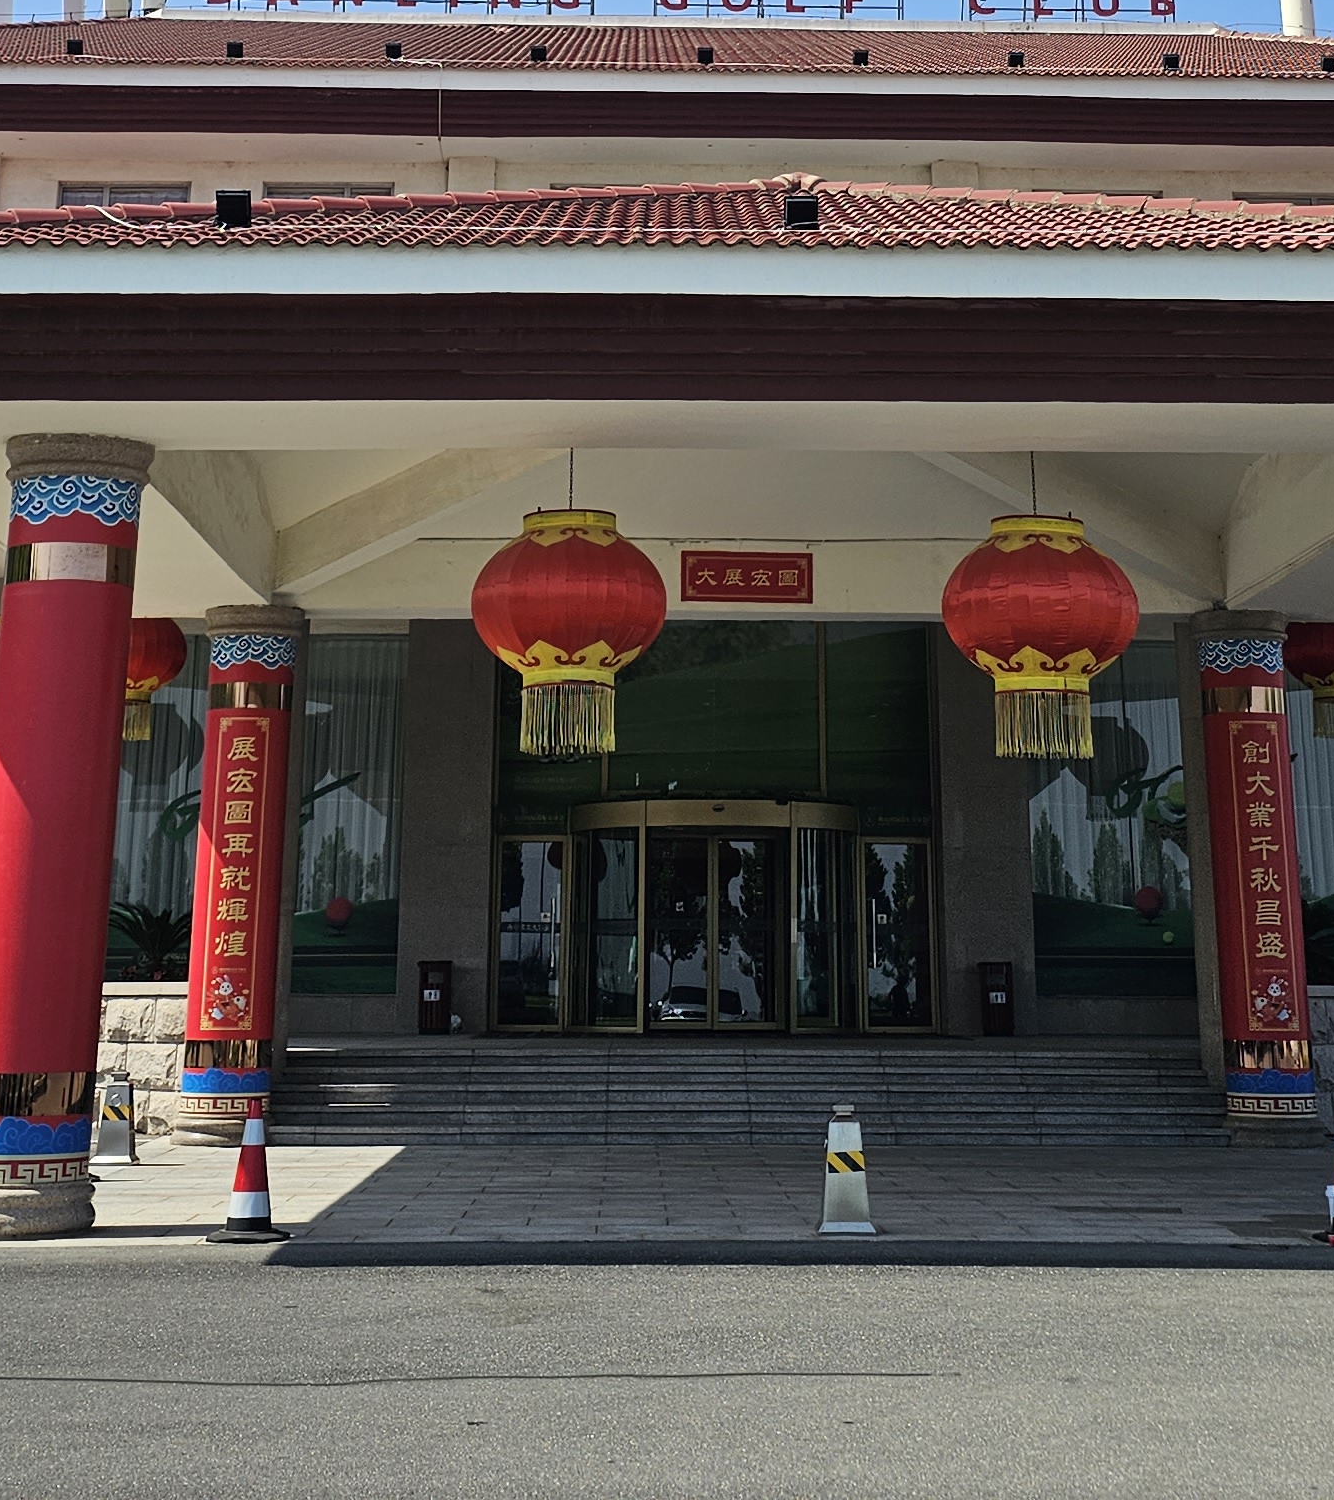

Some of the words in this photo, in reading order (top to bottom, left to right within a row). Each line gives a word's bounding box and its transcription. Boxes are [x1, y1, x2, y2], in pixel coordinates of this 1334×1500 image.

[695, 568, 798, 587] 大展宏圖
[214, 736, 258, 957] 展宏圖再就輝煌
[1242, 740, 1287, 959] 創大業千秋昌盛
